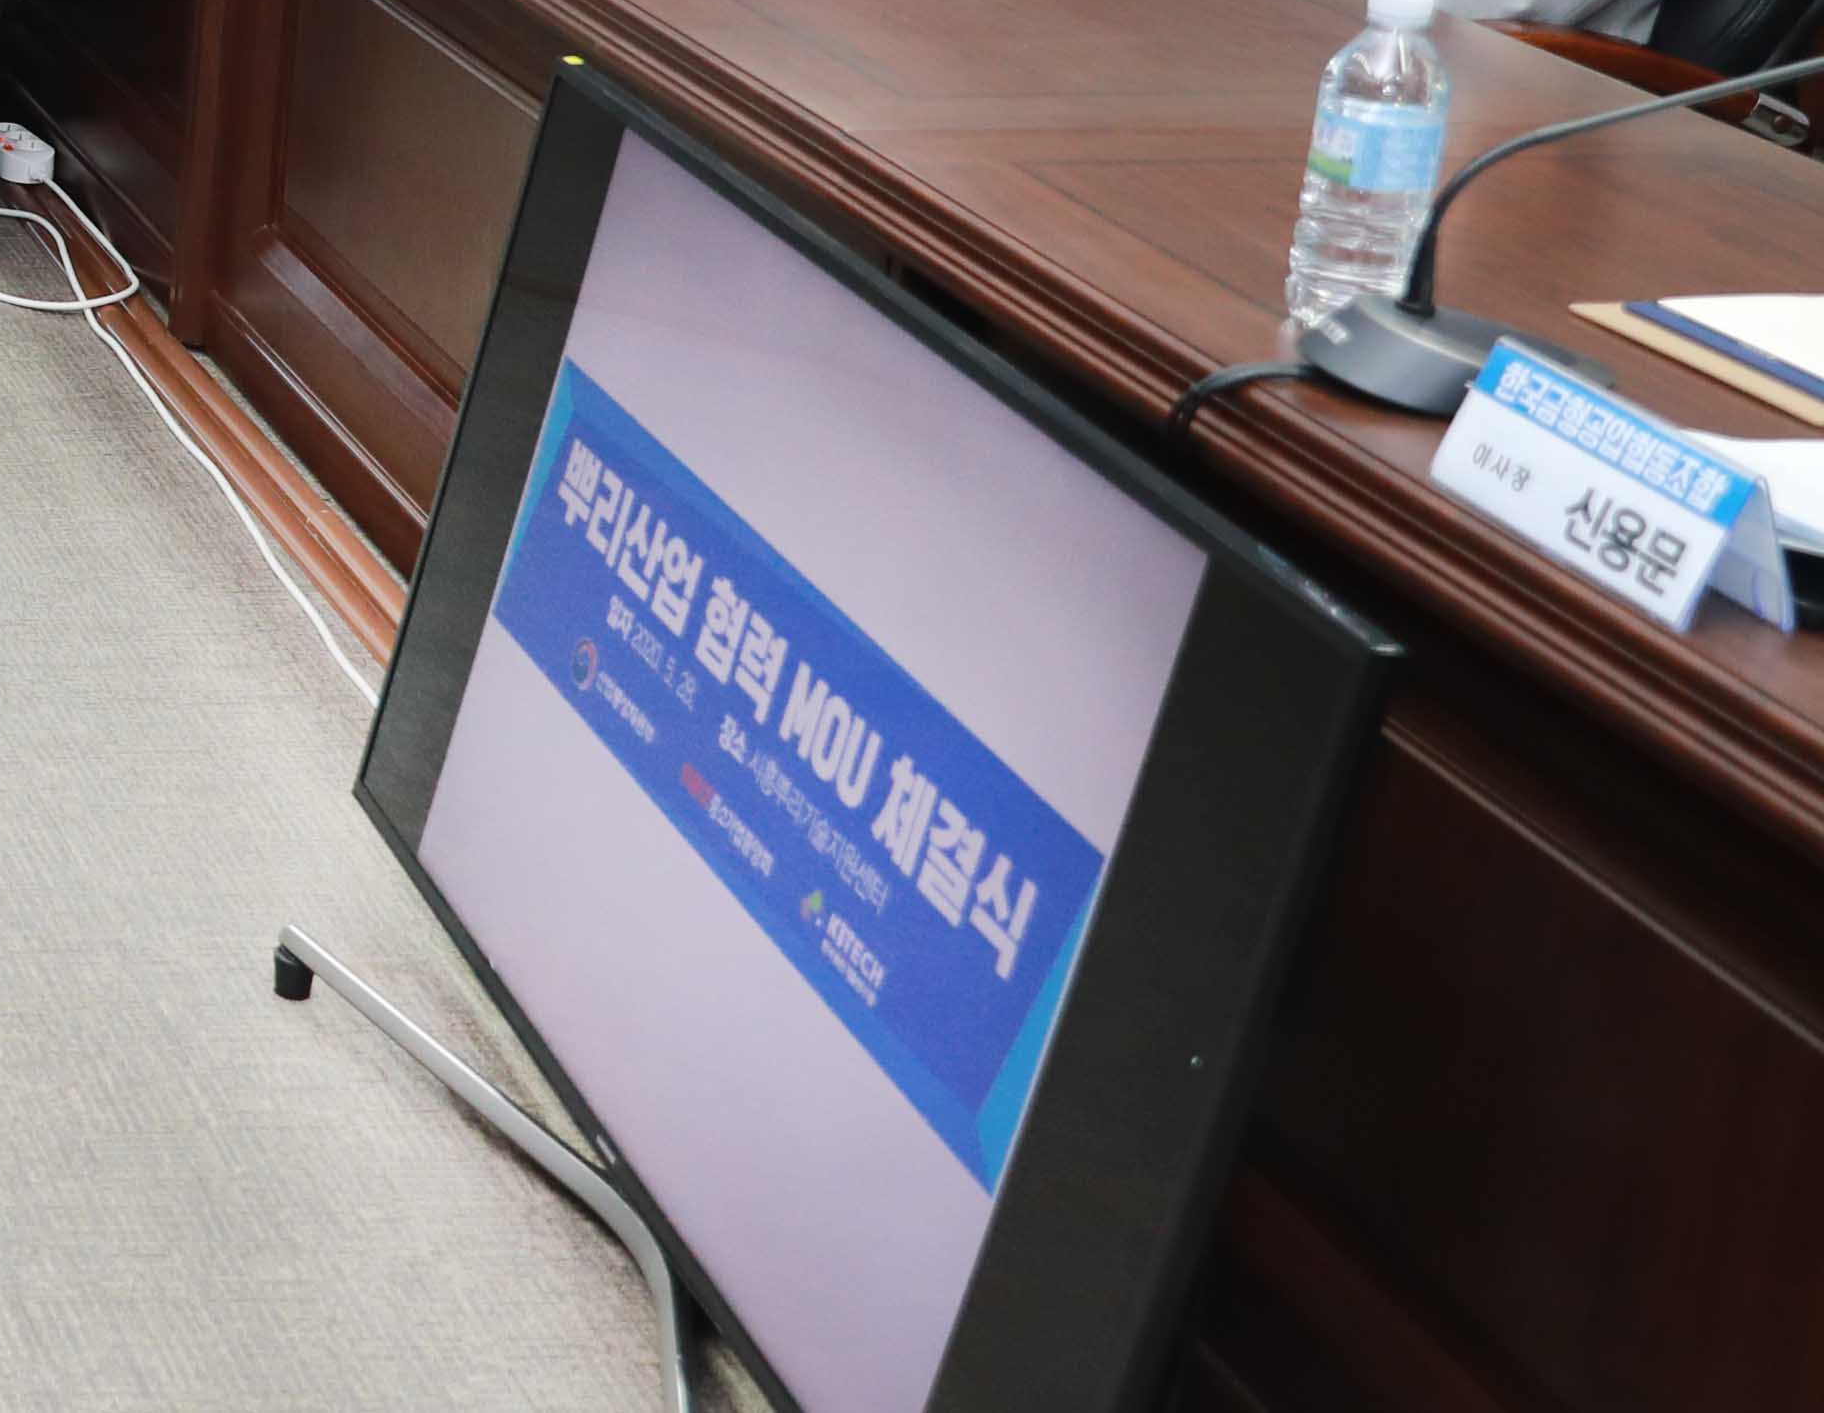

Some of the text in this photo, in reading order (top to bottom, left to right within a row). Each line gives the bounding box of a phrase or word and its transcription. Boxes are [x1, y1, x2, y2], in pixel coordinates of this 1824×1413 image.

[1493, 359, 1730, 513] 한국금형공업협동조합
[1563, 487, 1688, 598] 신용문
[558, 440, 704, 636] 뿌리산업
[695, 577, 788, 724] 협력
[779, 662, 882, 808] MOU
[871, 755, 1037, 979] 체결식
[825, 913, 887, 989] KITECH
